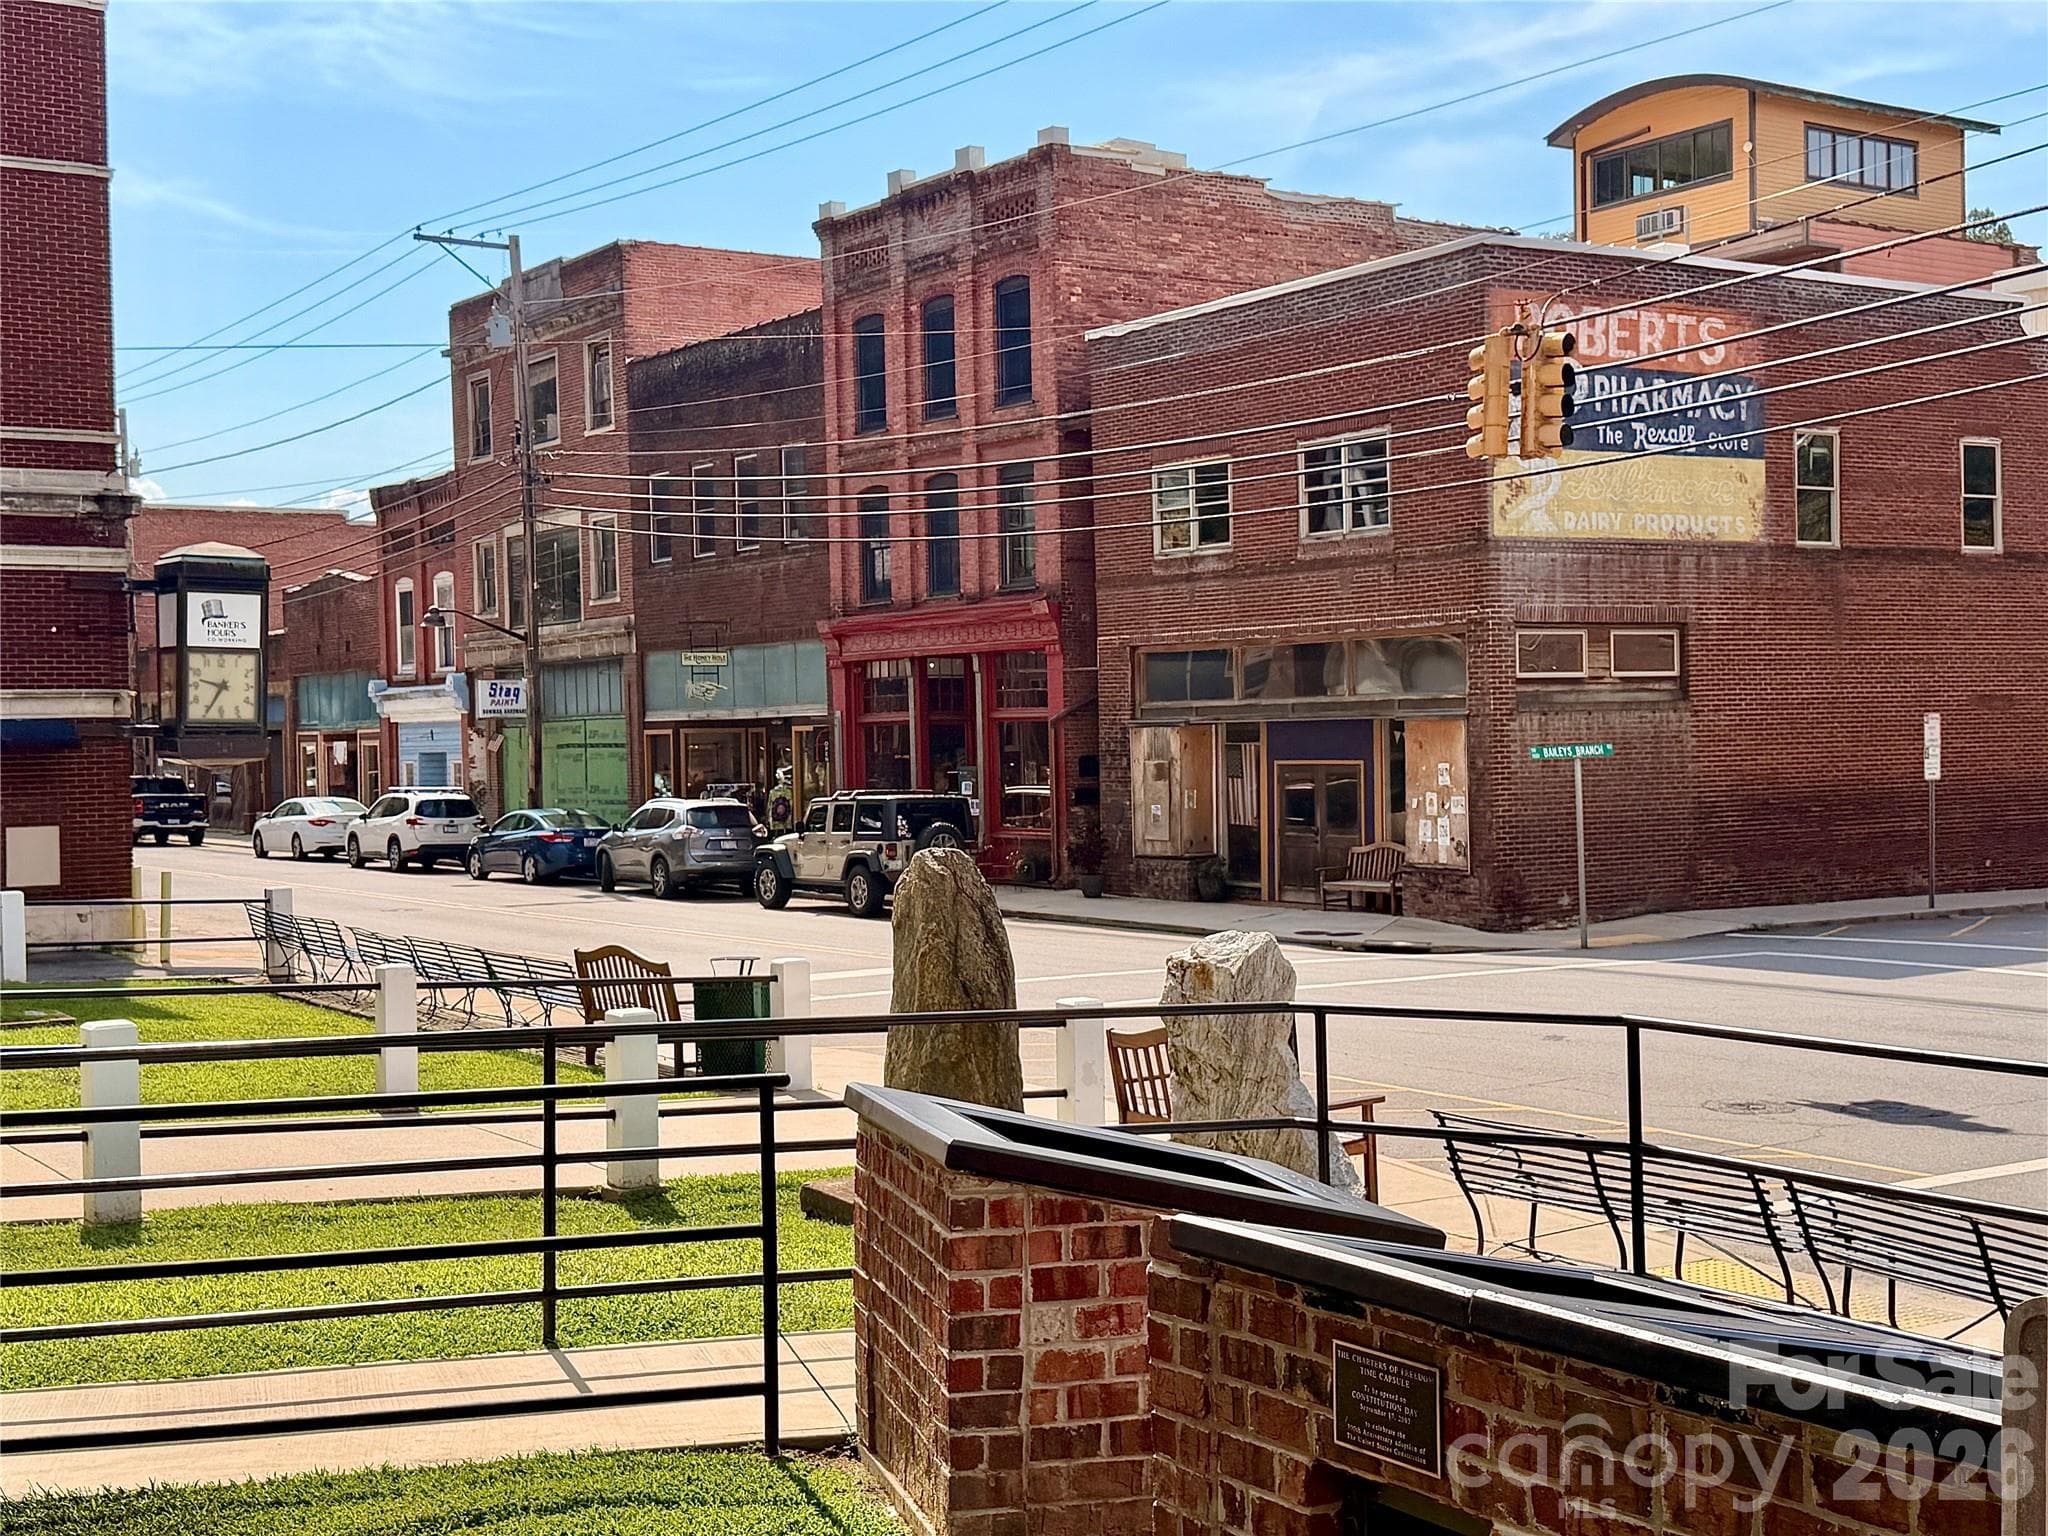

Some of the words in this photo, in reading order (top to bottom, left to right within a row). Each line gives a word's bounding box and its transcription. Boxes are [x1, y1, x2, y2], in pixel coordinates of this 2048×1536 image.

[1594, 374, 1753, 421] PHARMACY
[1597, 426, 1623, 444] The
[1631, 422, 1697, 452] Rexall
[1708, 432, 1749, 451] Store
[1564, 510, 1622, 531] DAIRY
[1634, 512, 1747, 534] PRODUCTS
[207, 629, 236, 637] HOURS
[489, 683, 521, 704] Stag
[1542, 746, 1573, 758] BAILEYS
[1575, 744, 1605, 756] BRANCH
[1337, 1349, 1350, 1360] THE
[1352, 1354, 1387, 1371] CHARTERS
[1389, 1365, 1399, 1374] OF
[1360, 1367, 1377, 1379] TIME
[1379, 1373, 1410, 1389] CAPSULE
[1351, 1390, 1402, 1413] CONSTITUTION
[1404, 1406, 1417, 1418] DAY
[1380, 1391, 1399, 1401] opened
[1360, 1403, 1387, 1417] September
[1397, 1431, 1406, 1440] the
